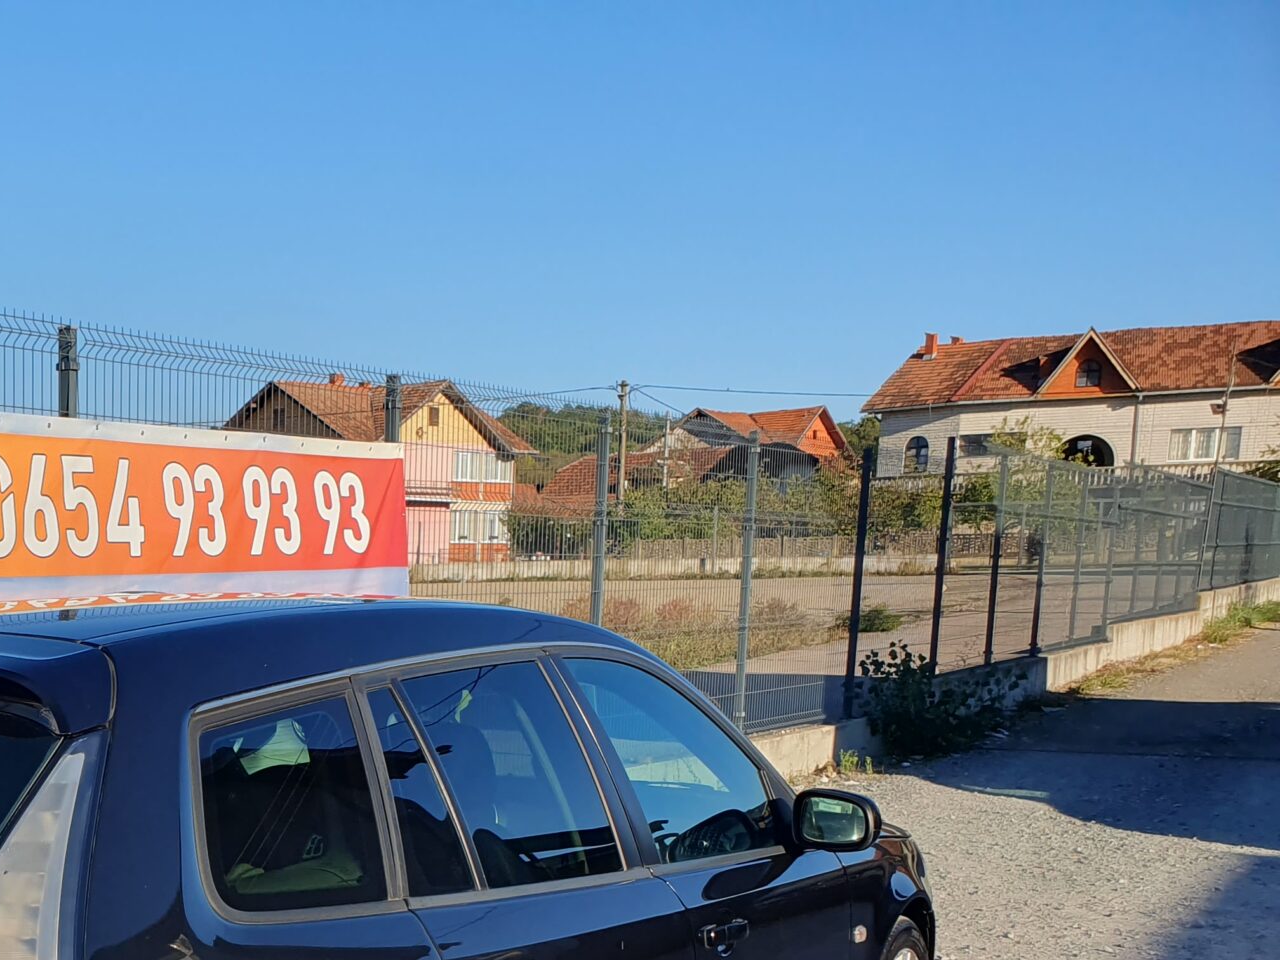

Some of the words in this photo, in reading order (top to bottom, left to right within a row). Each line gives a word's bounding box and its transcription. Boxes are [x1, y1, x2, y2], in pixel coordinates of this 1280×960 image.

[161, 461, 227, 557] 93
[241, 464, 299, 556] 93
[314, 469, 372, 555] 93
